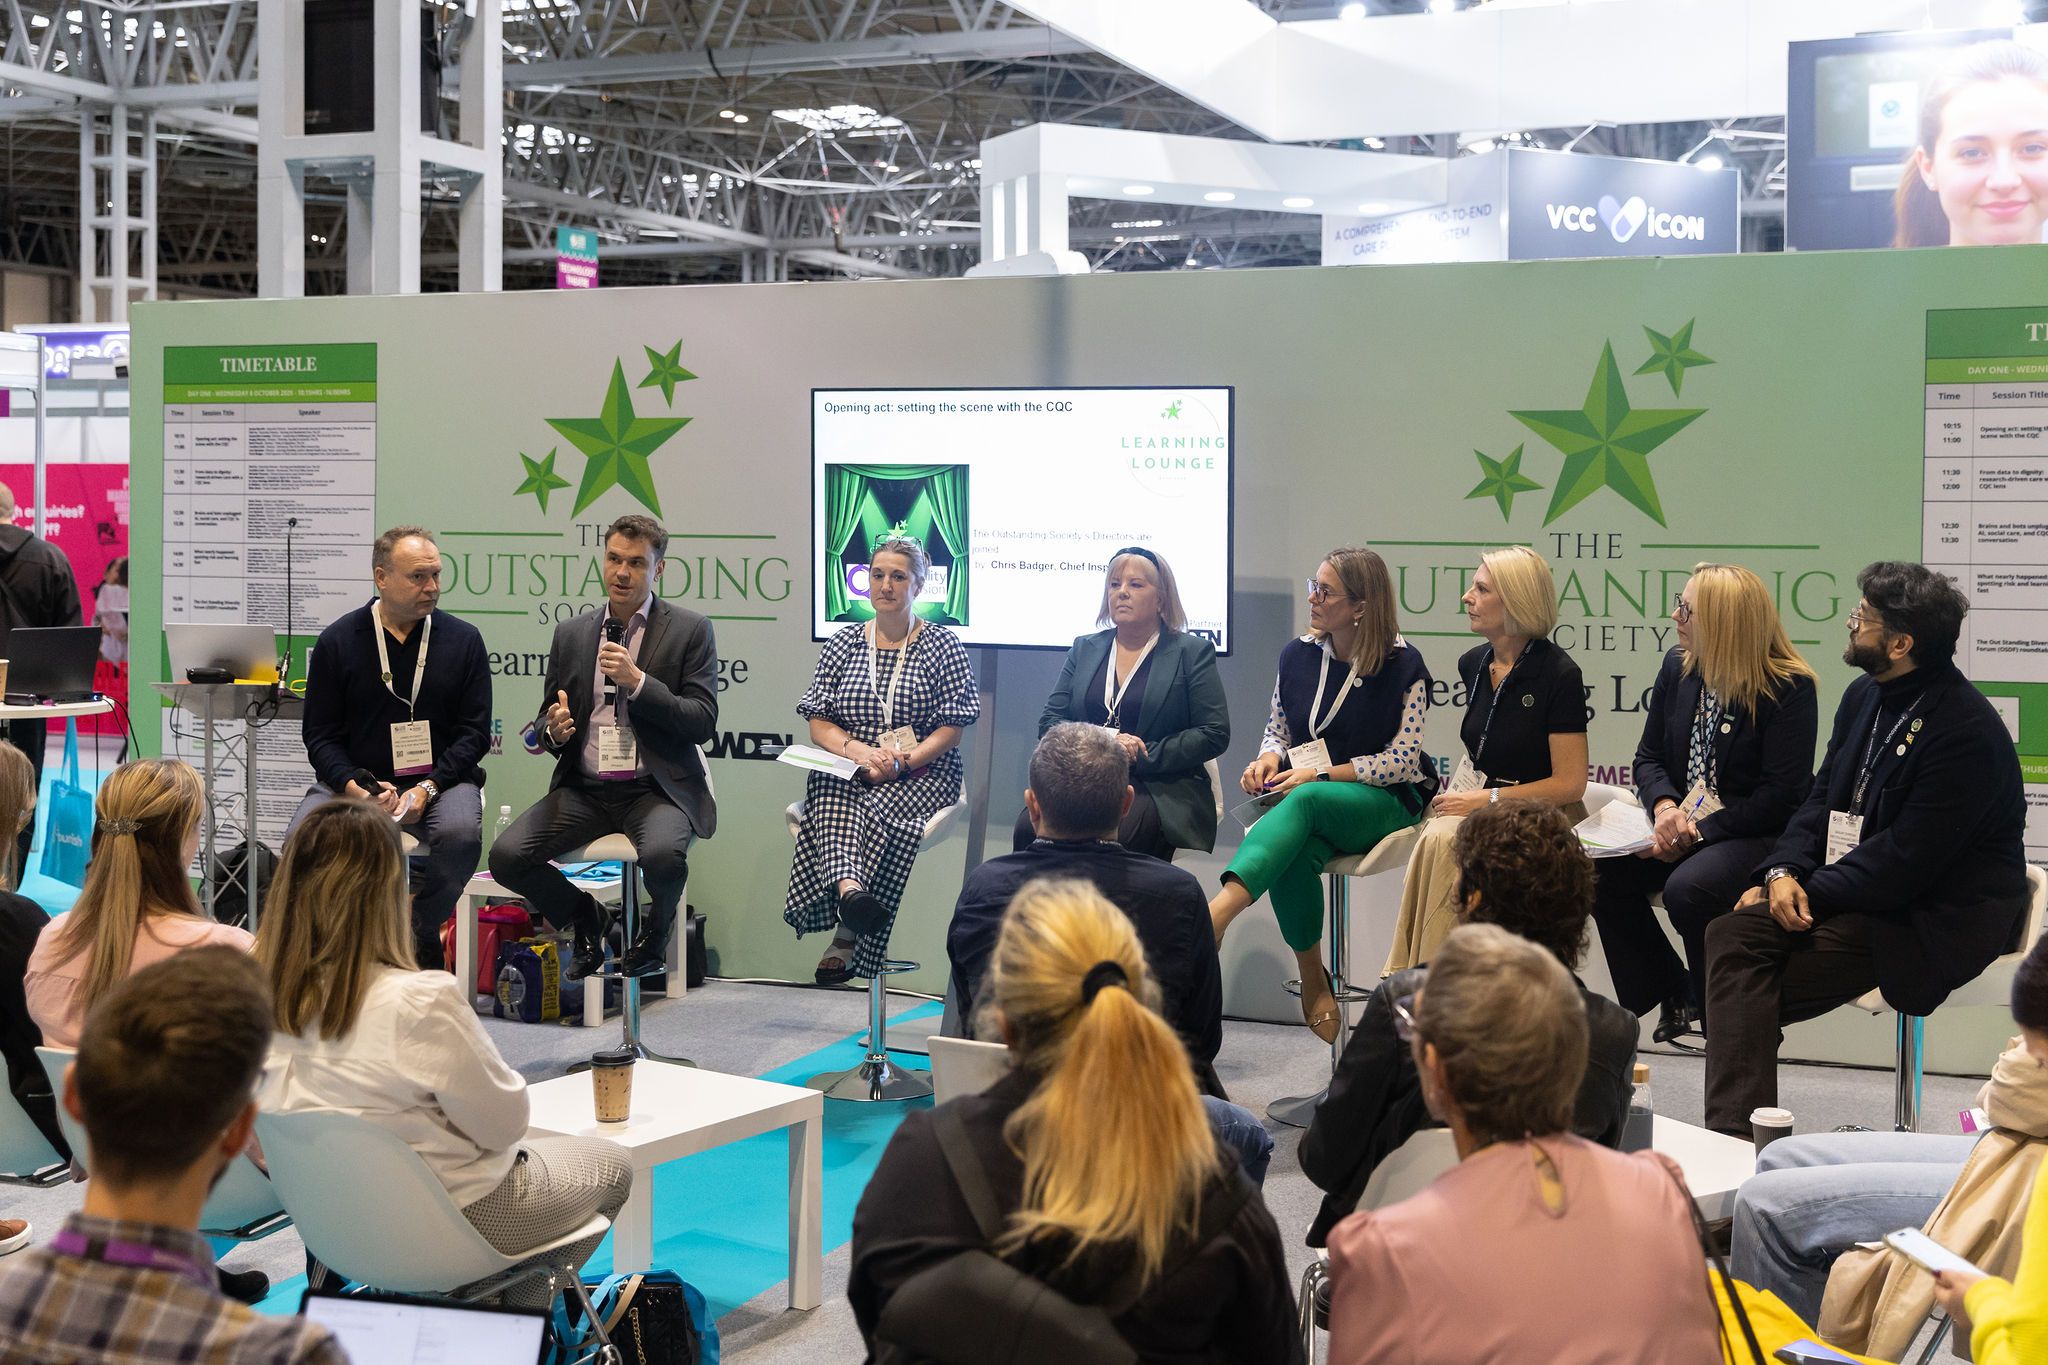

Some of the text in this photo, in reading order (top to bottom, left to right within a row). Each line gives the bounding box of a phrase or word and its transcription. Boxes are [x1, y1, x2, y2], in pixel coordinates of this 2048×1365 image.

[1545, 203, 1596, 233] VCC
[1353, 241, 1377, 256] CARE
[219, 356, 317, 373] TIMETABLE
[1968, 366, 1987, 375] DAY
[1988, 365, 2009, 374] ONE
[1938, 392, 1961, 400] Time
[1992, 391, 2027, 400] Session
[824, 400, 1073, 415] Opening act: setting the scene with the CQC
[1121, 436, 1227, 449] LEARNING
[1132, 456, 1215, 470] LOUNGE
[973, 529, 990, 539] The
[992, 529, 1046, 541] Outstanding
[1092, 530, 1134, 541] Directors
[1136, 533, 1152, 541] are
[971, 545, 999, 555] joined
[1550, 533, 1624, 559] THE
[974, 560, 985, 570] by
[990, 560, 1017, 570] Chris
[1059, 561, 1085, 571] Chief
[440, 551, 793, 602] OUTSTADING
[1189, 619, 1222, 628] Partner
